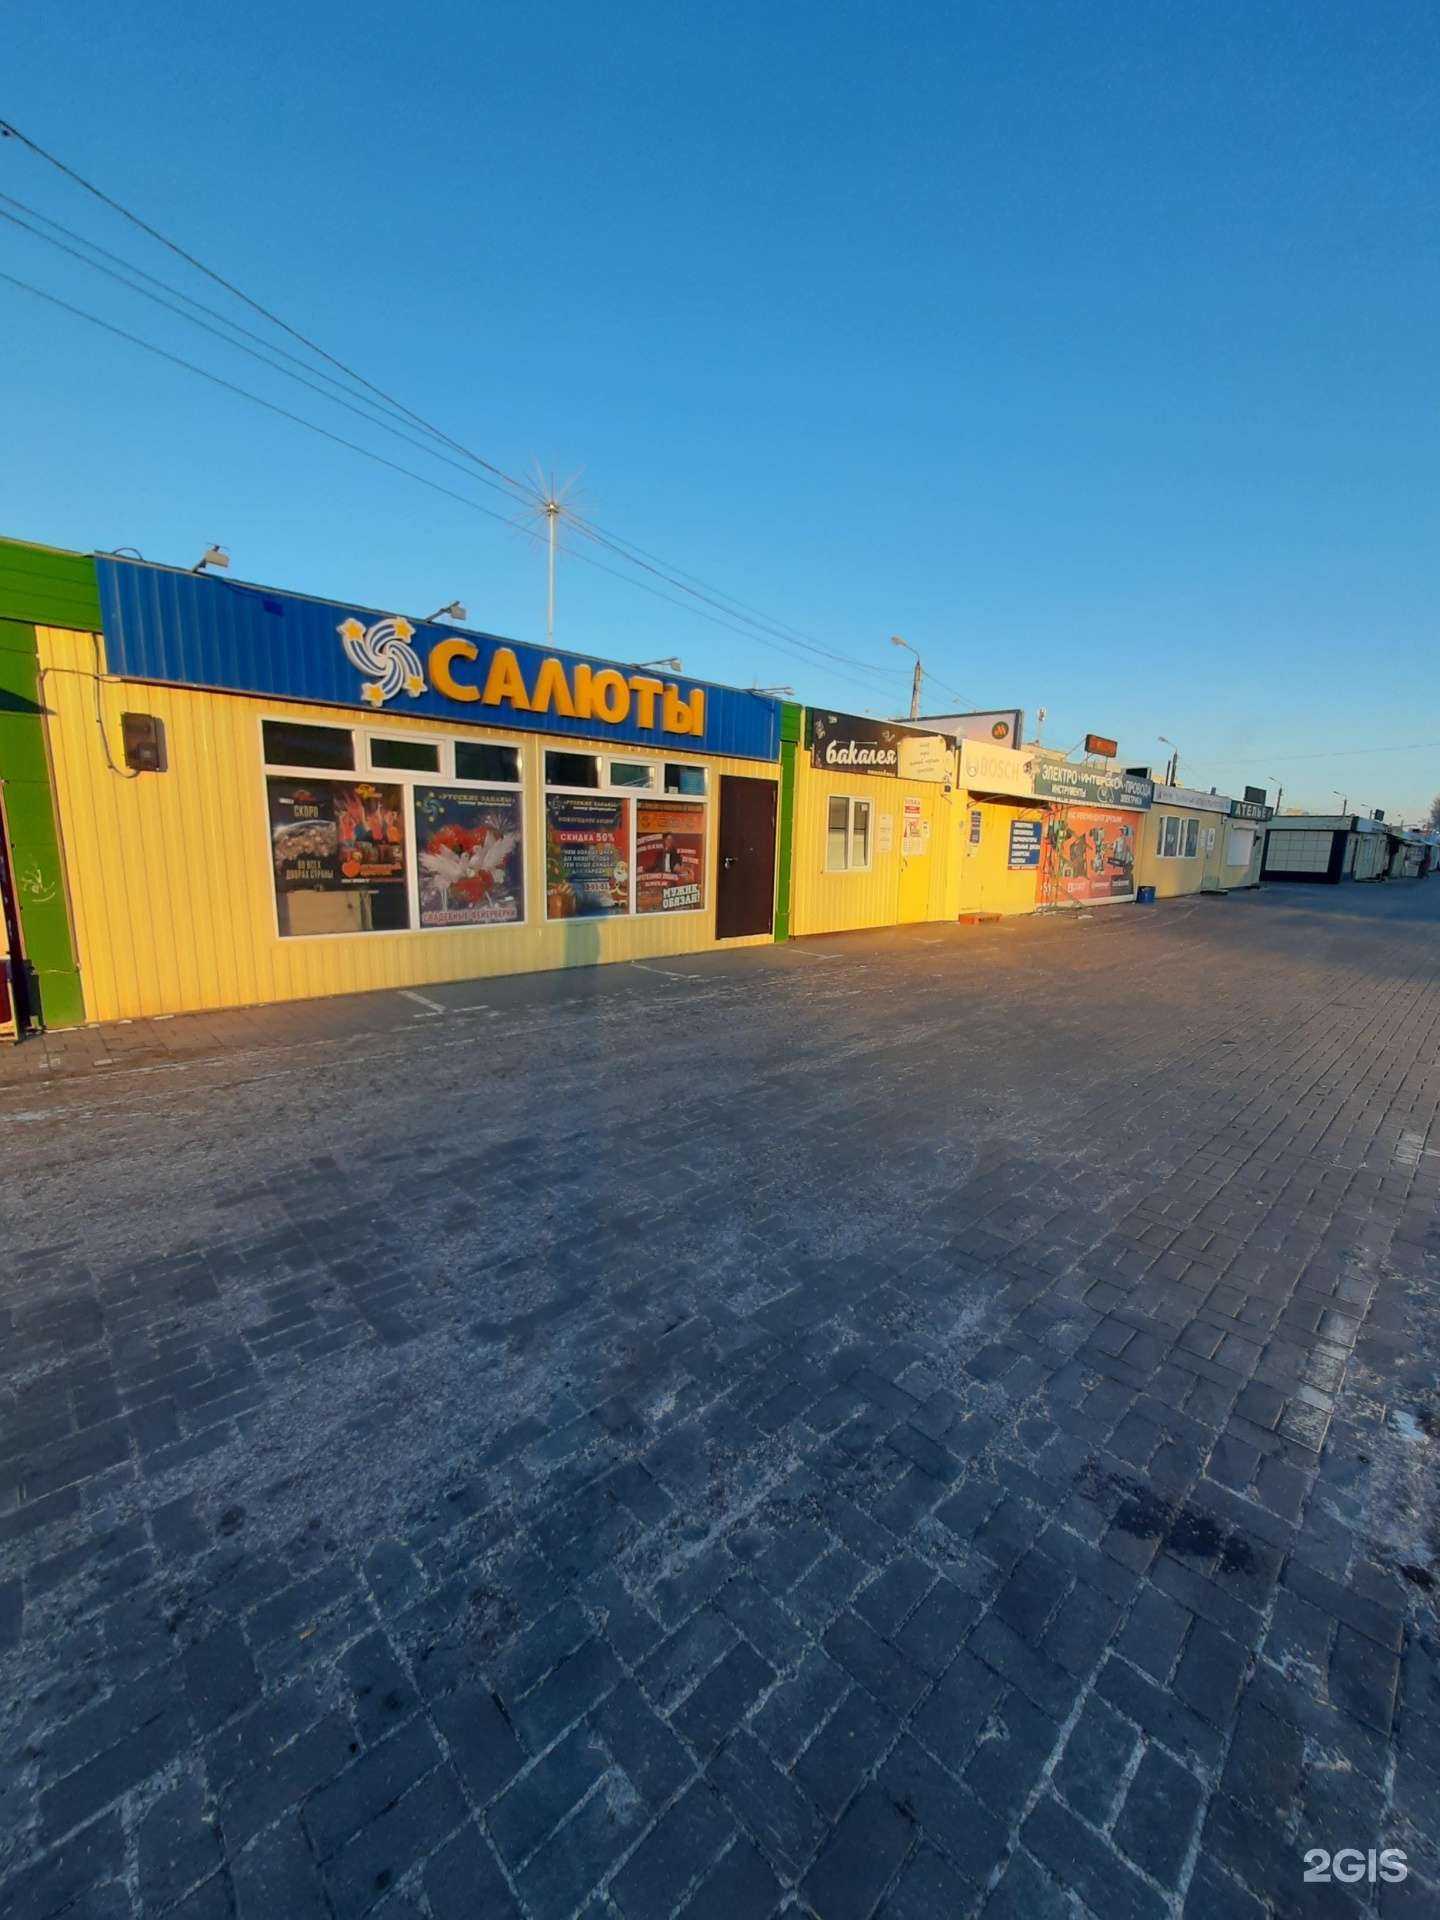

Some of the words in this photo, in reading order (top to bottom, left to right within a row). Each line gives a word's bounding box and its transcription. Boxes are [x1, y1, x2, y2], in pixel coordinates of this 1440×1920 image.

[428, 637, 705, 736] САЛЮТЫ
[826, 739, 897, 765] бакалея
[1042, 764, 1078, 785] ЭЛЕКТРО
[294, 805, 319, 817] СКОРО
[1235, 805, 1265, 819] АТЕЛЬЕ
[560, 832, 594, 841] СКИДКА
[596, 832, 615, 842] 50%
